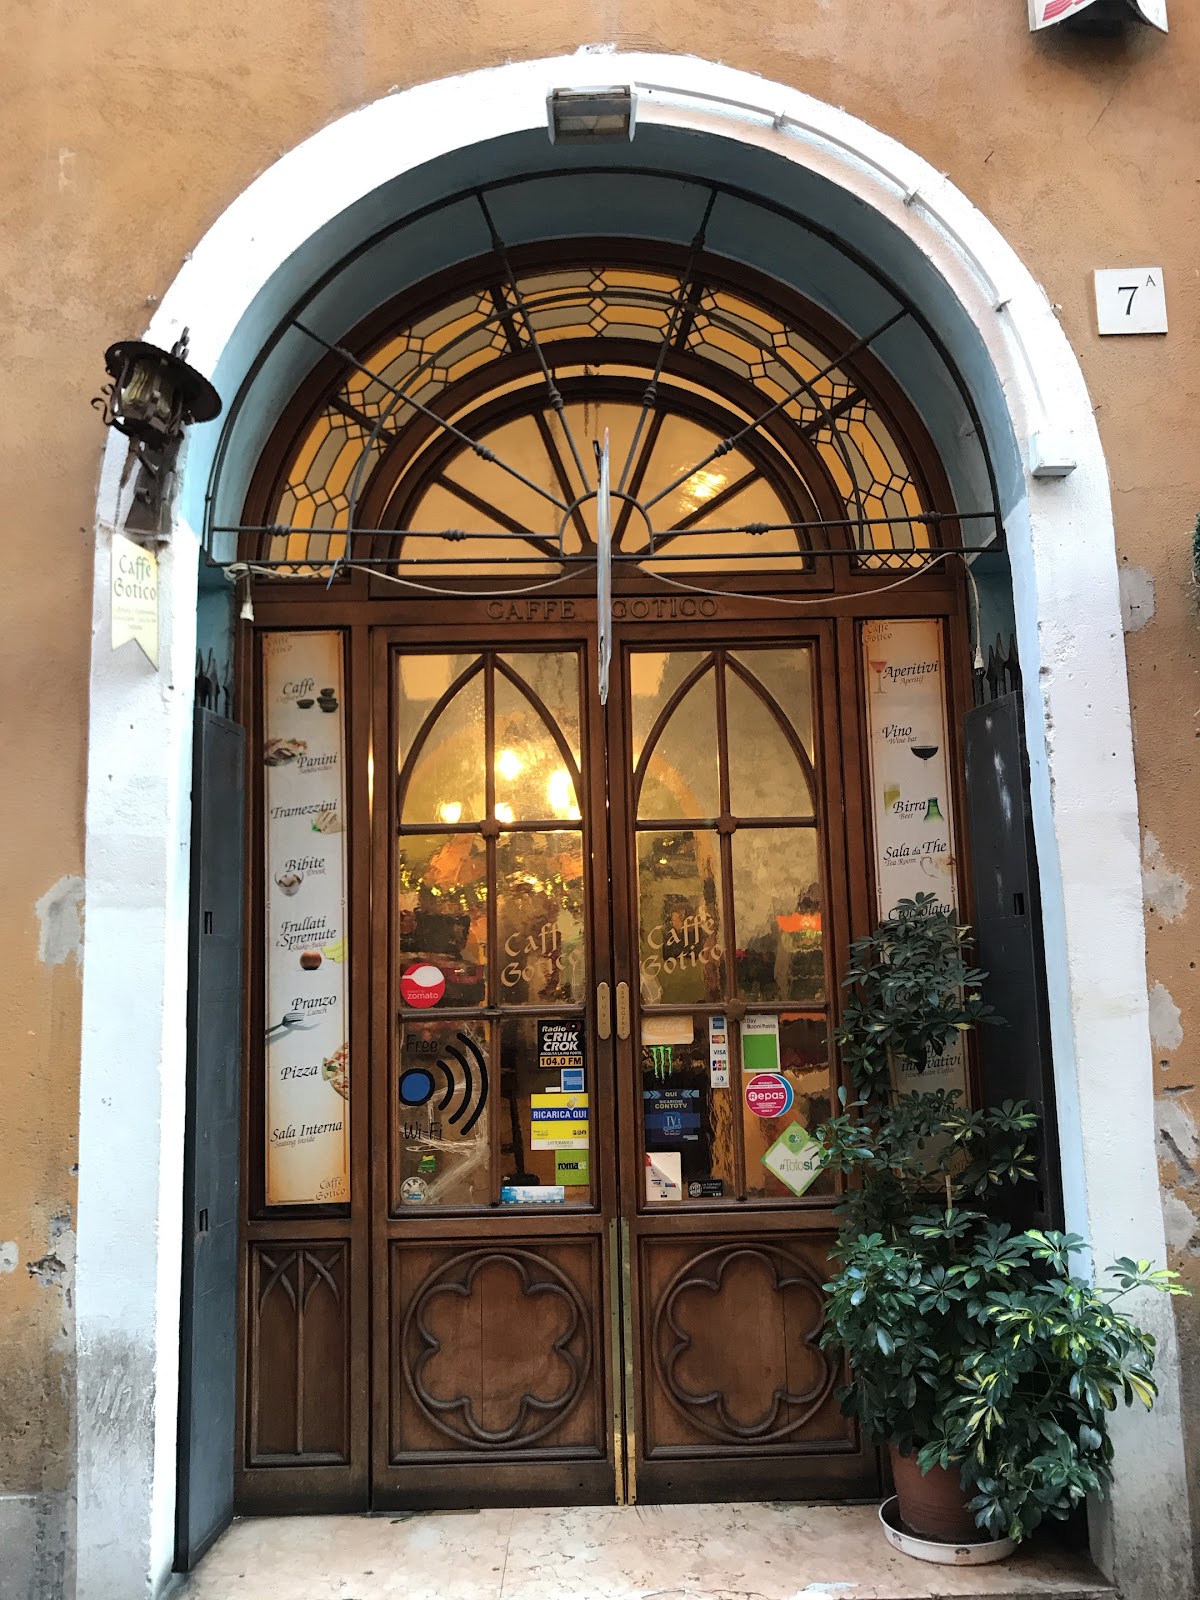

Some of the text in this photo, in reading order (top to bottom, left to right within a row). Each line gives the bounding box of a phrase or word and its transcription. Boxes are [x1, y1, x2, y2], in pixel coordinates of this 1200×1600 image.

[113, 577, 157, 601] Gotico
[486, 598, 719, 620] CAFFE GOTICO
[883, 660, 939, 683] Aperitivi
[900, 675, 924, 688] Aperitif
[882, 724, 913, 739] Vino
[887, 734, 918, 745] Wine bar
[298, 752, 338, 769] Panini
[271, 799, 338, 819] Tramezzini
[893, 800, 926, 814] Birra
[884, 839, 947, 861] Sala da The
[285, 856, 325, 873] Bibite
[885, 857, 917, 867] Tea Room
[306, 868, 327, 876] Drink
[280, 916, 327, 936] Frullati
[280, 928, 337, 950] Spremute
[642, 943, 725, 978] Gotico
[500, 950, 579, 988] Gotico
[291, 995, 337, 1012] Pranzo
[407, 991, 439, 1000] zomato
[306, 1008, 327, 1017] Lunch
[406, 1034, 438, 1053] Free
[543, 1032, 579, 1042] CRIK
[543, 1041, 579, 1051] CROK
[568, 1057, 581, 1065] FM
[280, 1065, 319, 1081] Pizza
[533, 1110, 587, 1119] RICARICA QUI
[270, 1121, 343, 1143] Sala Interna
[404, 1121, 443, 1140] Wi-Fi
[274, 1136, 316, 1149] Seating inside
[315, 1188, 346, 1201] Gotico
